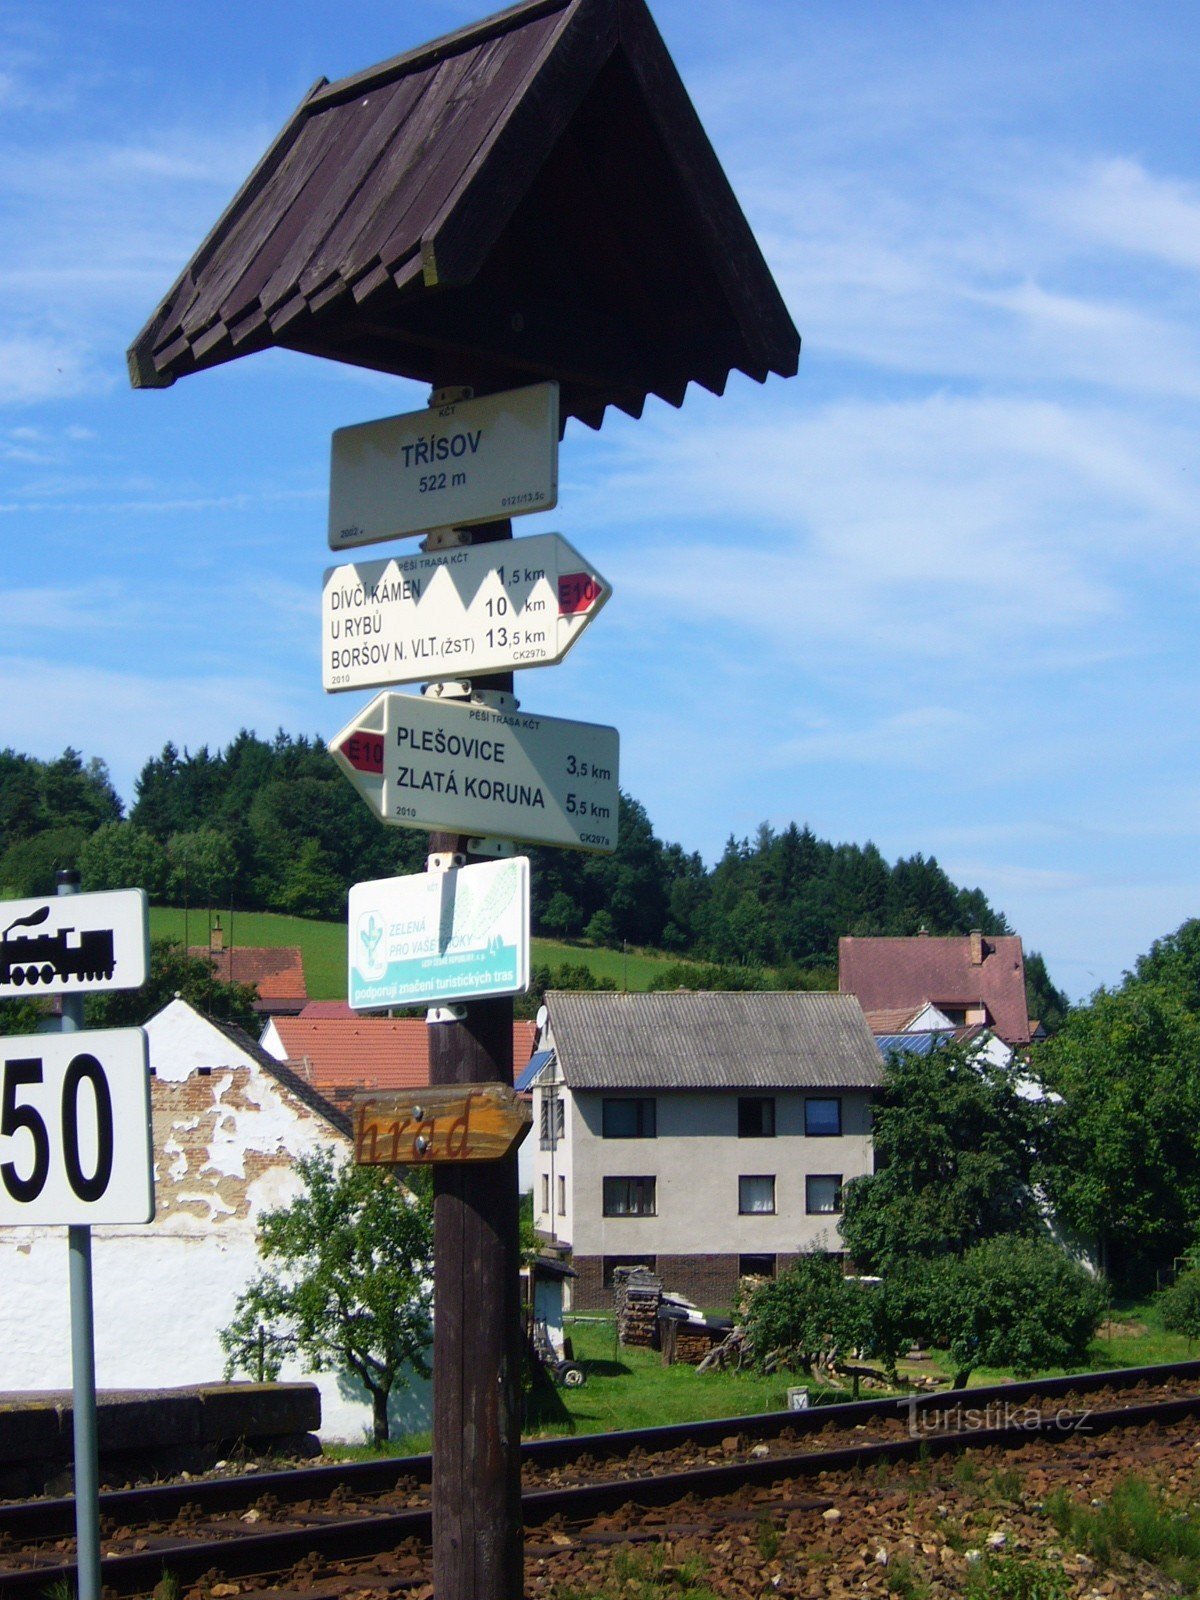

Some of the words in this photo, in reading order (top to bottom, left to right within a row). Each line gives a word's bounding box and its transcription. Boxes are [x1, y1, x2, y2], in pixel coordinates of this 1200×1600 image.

[401, 430, 482, 468] TŘÍSOV
[419, 473, 446, 493] 522
[452, 473, 466, 486] m
[419, 556, 449, 568] TRASA
[451, 551, 469, 563] KČT
[496, 565, 520, 587] 1,5
[525, 567, 545, 582] km
[331, 582, 368, 611] DÍVČÍ
[371, 578, 421, 605] KÁMEN
[560, 582, 594, 605] E10
[485, 597, 507, 618] 10
[525, 599, 546, 612] km
[331, 621, 340, 640] U
[344, 610, 382, 638] RYBŮ
[485, 628, 520, 648] 13,5
[525, 631, 546, 644] km
[331, 642, 390, 669] BORŠOV
[394, 642, 408, 661] N.
[411, 637, 439, 658] VLT.
[440, 638, 475, 658] (ŽST)
[513, 649, 546, 660] CK297b
[331, 675, 350, 684] 2010
[469, 710, 489, 722] PĚŠÍ
[492, 714, 521, 728] TRASA
[522, 717, 540, 730] KČT
[349, 739, 384, 764] E10
[397, 727, 505, 763] PLEŠOVICE
[566, 755, 588, 777] 3,5
[591, 765, 611, 780] km
[397, 767, 458, 795] ZLATÁ
[465, 777, 545, 808] KORUNA
[396, 806, 416, 817] 2010
[566, 794, 588, 815] 5,5
[591, 804, 610, 818] km
[579, 832, 610, 846] CK297a
[389, 917, 426, 936] ZELENÁ
[389, 940, 410, 956] PRO
[412, 937, 436, 955] VAŠE
[354, 983, 397, 1000] podporují
[399, 979, 433, 994] značení
[436, 972, 491, 991] turistických
[494, 970, 513, 982] tras
[0, 1053, 114, 1203] 50
[355, 1090, 483, 1163] hrad
